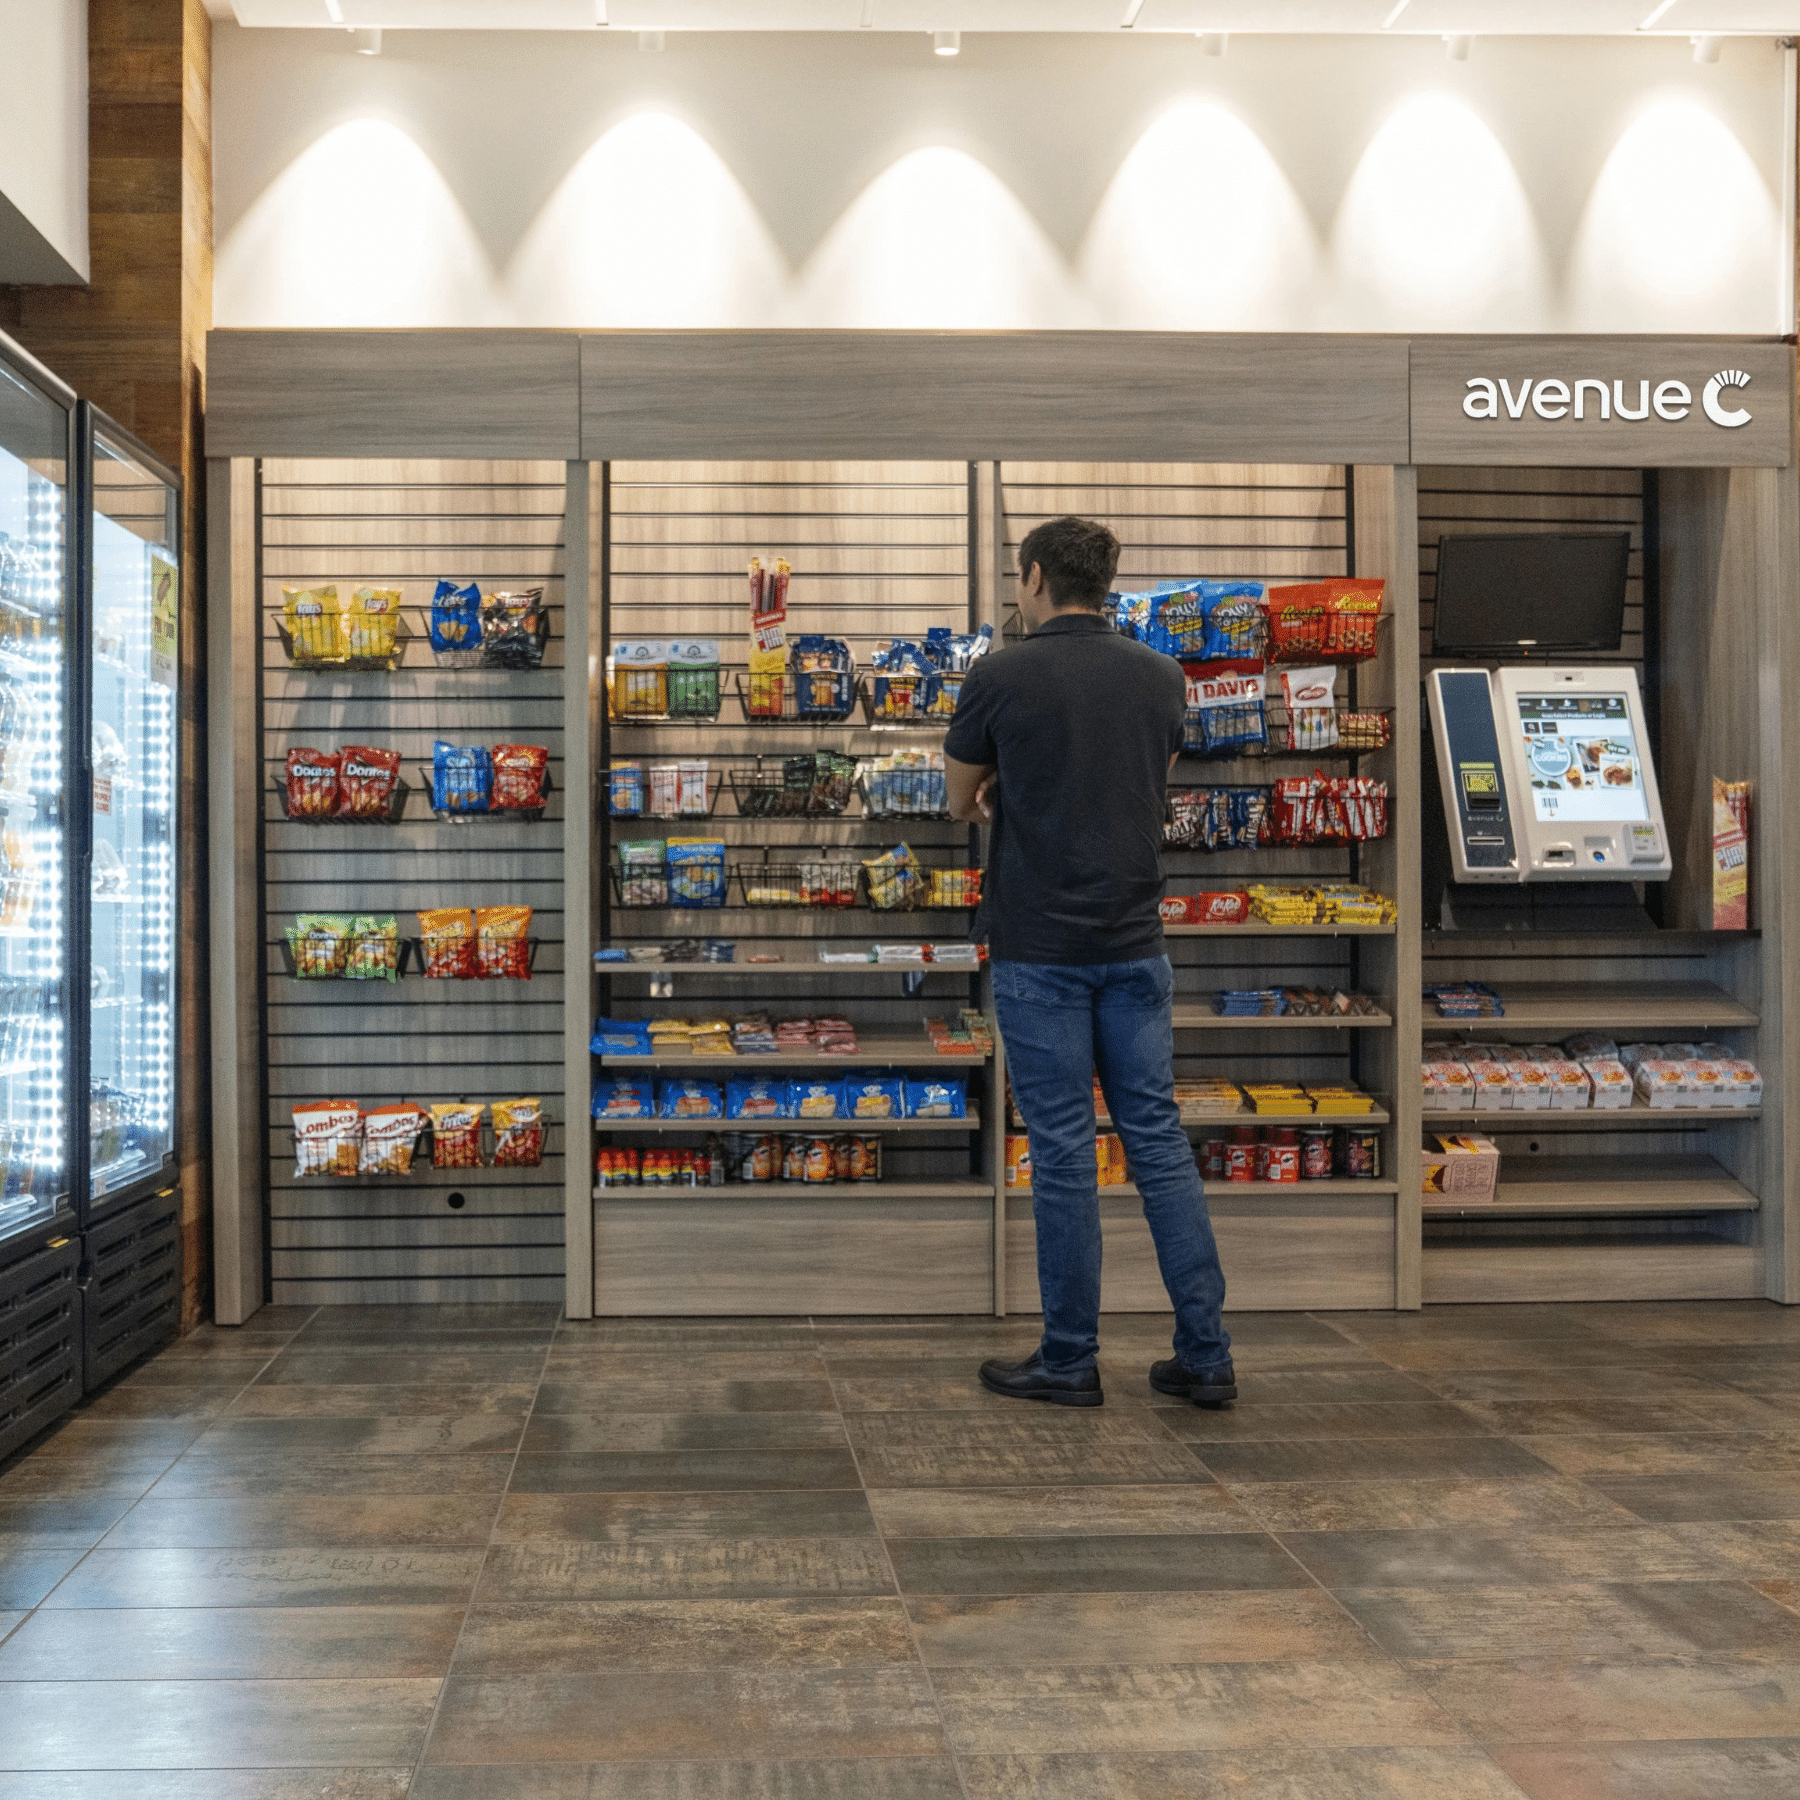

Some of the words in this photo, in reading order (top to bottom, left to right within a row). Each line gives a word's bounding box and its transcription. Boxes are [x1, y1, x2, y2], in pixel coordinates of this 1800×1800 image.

[1462, 377, 1692, 420] avenue
[1165, 601, 1198, 617] JOLLY
[292, 764, 336, 777] Doritos
[346, 763, 391, 780] Doritos
